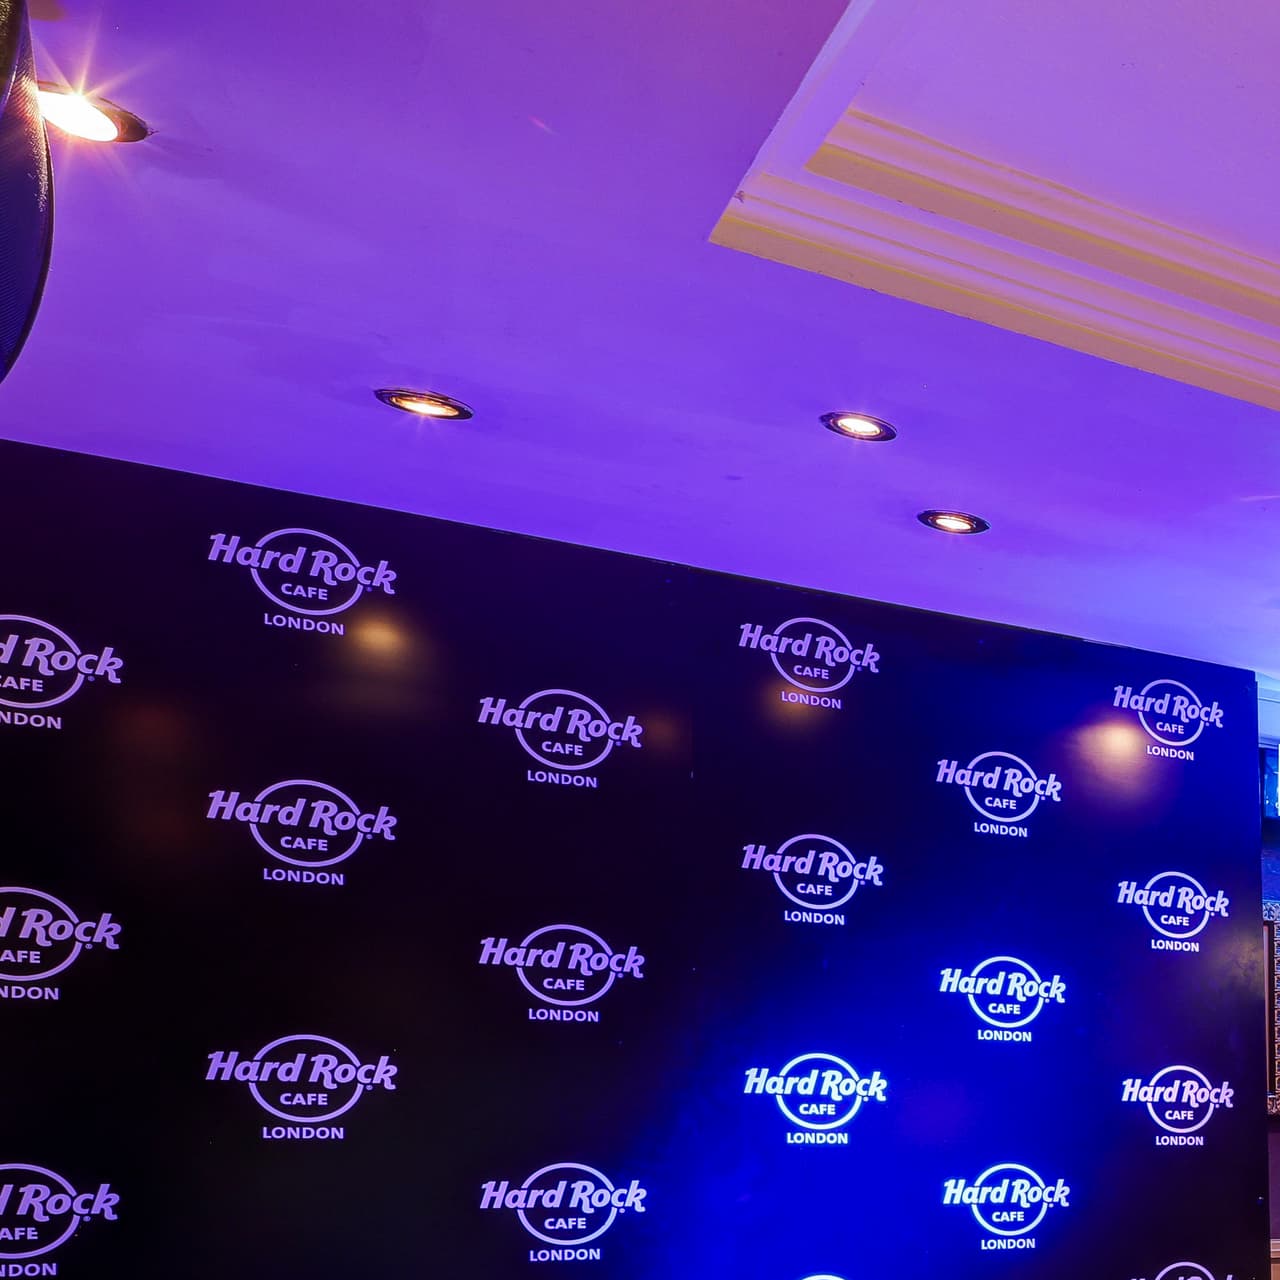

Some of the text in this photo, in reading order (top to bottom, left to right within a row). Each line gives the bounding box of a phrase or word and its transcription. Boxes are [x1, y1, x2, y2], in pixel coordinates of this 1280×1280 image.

[207, 532, 398, 595] Hard Rock
[280, 582, 329, 601] CAFE
[263, 612, 344, 636] LONDON
[738, 622, 881, 674] Hard Rock
[21, 637, 124, 684] Rock
[793, 664, 830, 680] CAFE
[0, 674, 44, 693] AFE
[781, 690, 842, 710] LONDON
[1112, 684, 1224, 728] Hard Rock
[0, 710, 62, 730] NDON
[477, 696, 643, 748] Hard Rock
[1155, 721, 1185, 735] CAFE
[541, 740, 584, 756] CAFE
[1146, 744, 1195, 761] LONDON
[527, 769, 597, 789] LONDON
[935, 759, 1062, 802] Hard Rock
[984, 796, 1017, 810] CAFE
[206, 789, 398, 841] Hard Rock
[974, 821, 1028, 838] LONDON
[280, 835, 328, 852] CAFE
[741, 843, 884, 887] Hard Rock
[263, 867, 344, 886] LONDON
[796, 882, 833, 896] CAFE
[1117, 880, 1230, 918] Hard Rock
[784, 910, 845, 926] LONDON
[1160, 914, 1190, 927] CAFE
[18, 908, 122, 950] Rock
[1151, 939, 1200, 953] LONDON
[0, 949, 41, 964] AFE
[478, 937, 646, 979] Hard Rock
[542, 977, 585, 991] CAFE
[939, 968, 1066, 1004] Hard Rock
[0, 985, 59, 1001] NDON
[528, 1007, 599, 1023] LONDON
[988, 1003, 1021, 1015] CAFE
[977, 1029, 1032, 1042] LONDON
[205, 1050, 398, 1091] Hard Rock
[743, 1067, 888, 1102] Hard Rock
[1121, 1078, 1234, 1108] Hard Rock
[279, 1092, 328, 1106] CAFE
[799, 1103, 836, 1115] CAFE
[1165, 1110, 1194, 1121] CAFE
[262, 1126, 344, 1140] LONDON
[787, 1132, 848, 1144] LONDON
[1155, 1135, 1204, 1146] LONDON
[479, 1179, 648, 1214] Hard Rock
[942, 1178, 1070, 1209] Hard Rock
[15, 1183, 121, 1223] Rock
[544, 1217, 587, 1230] CAFE
[991, 1211, 1025, 1223] CAFE
[0, 1226, 39, 1241] AFE
[981, 1238, 1035, 1250] LONDON
[529, 1248, 601, 1262] LONDON
